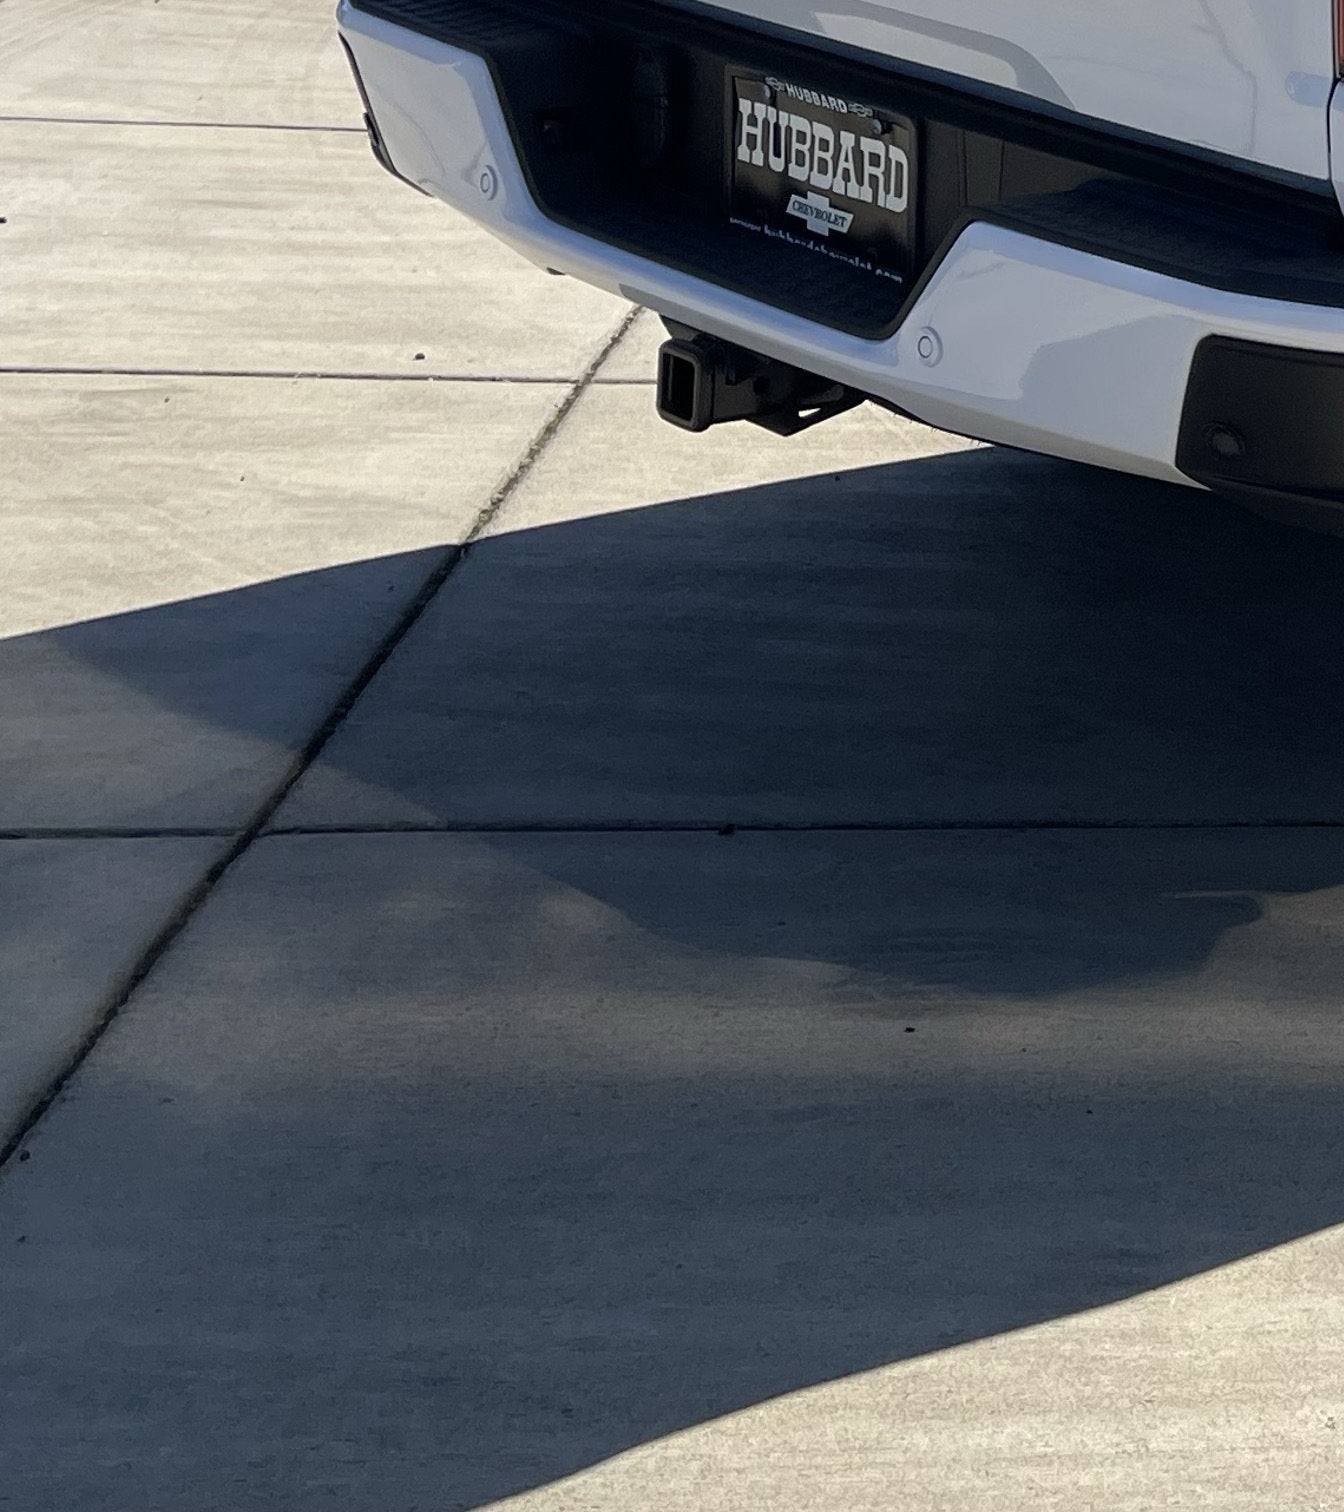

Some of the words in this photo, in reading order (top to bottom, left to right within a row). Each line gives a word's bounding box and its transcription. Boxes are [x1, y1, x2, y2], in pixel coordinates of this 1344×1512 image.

[785, 82, 848, 114] HUBBARD
[736, 97, 908, 213] HUBBARD
[791, 199, 848, 228] CHEVROLET
